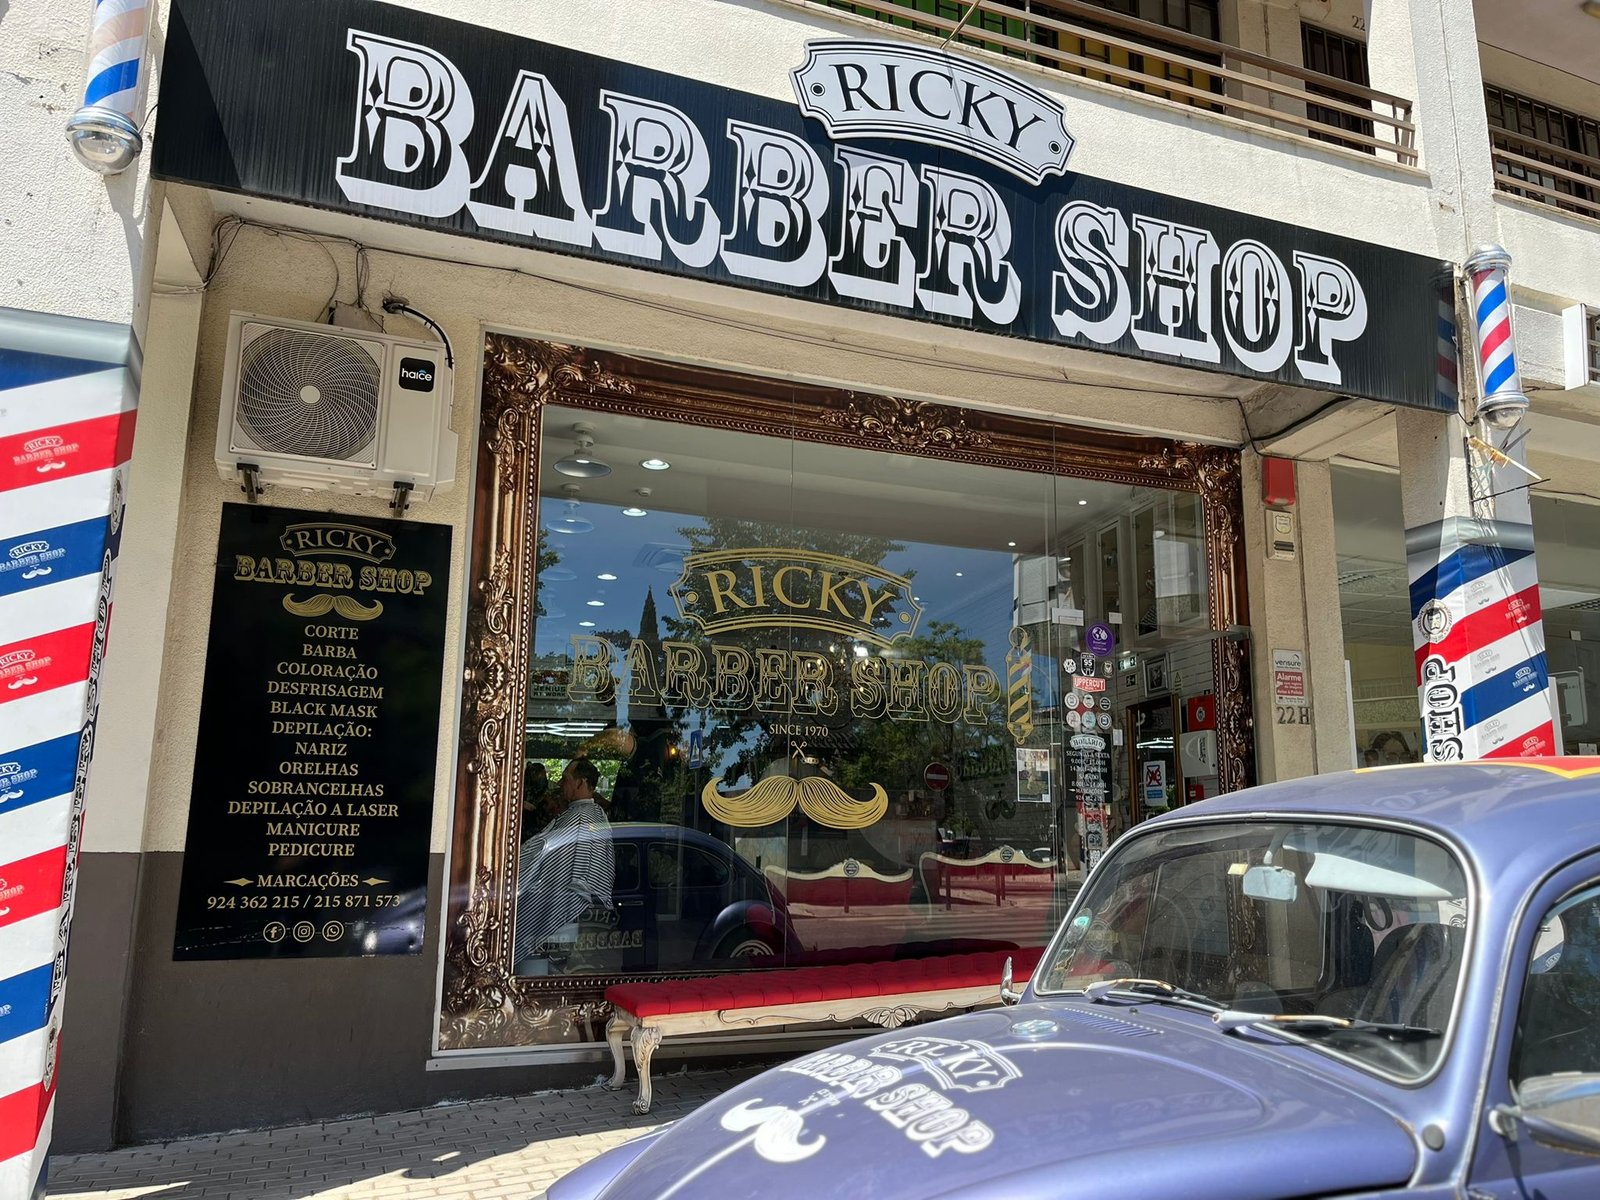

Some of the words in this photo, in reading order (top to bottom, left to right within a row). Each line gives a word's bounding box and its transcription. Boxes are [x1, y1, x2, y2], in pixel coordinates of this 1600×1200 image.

[827, 62, 1046, 152] RICKY
[335, 27, 1022, 326] BARBER
[1051, 200, 1369, 386] SHOP
[28, 437, 58, 450] RICKY
[14, 543, 45, 556] RICKY
[295, 530, 384, 556] RICKY
[40, 547, 66, 562] SHOP
[234, 554, 353, 589] BARBER
[359, 565, 432, 595] SHOP
[703, 565, 897, 627] RICKY
[304, 624, 359, 640] CORTE
[0, 652, 30, 665] RICKY
[302, 644, 357, 659] BARBA
[25, 656, 52, 671] SHOP
[276, 661, 378, 682] COLORAÇÃO
[568, 634, 839, 716] BARBER
[851, 655, 1002, 726] SHOP
[1074, 678, 1104, 688] UPPERCUT
[267, 681, 384, 699] DESFRISAGEM
[270, 701, 326, 716] BLACK
[330, 704, 378, 718] MASK
[1276, 706, 1296, 725] 22
[1298, 706, 1311, 725] H
[1426, 657, 1464, 762] SHOP
[272, 721, 372, 740] DEPILAÇÃO:
[769, 723, 800, 736] SINCE
[804, 725, 829, 737] 1970
[294, 742, 347, 756] NARIZ
[11, 768, 39, 785] SHOP
[279, 761, 359, 776] ORELHAS
[248, 781, 384, 797] SOBRANCELHAS
[228, 800, 327, 818] DEPILAÇÃO
[330, 803, 343, 816] A
[347, 803, 399, 817] LASER
[266, 823, 360, 837] MANICURE
[268, 843, 355, 857] PEDICURE
[257, 872, 359, 890] MARCAÇÕES
[207, 897, 236, 909] 924
[240, 896, 268, 909] 362
[273, 896, 299, 908] 215
[303, 895, 311, 908] /
[314, 895, 340, 908] 215
[345, 895, 370, 908] 871
[375, 894, 400, 907] 573
[896, 1040, 1000, 1080] RICKY
[863, 1083, 994, 1158] SHOP
